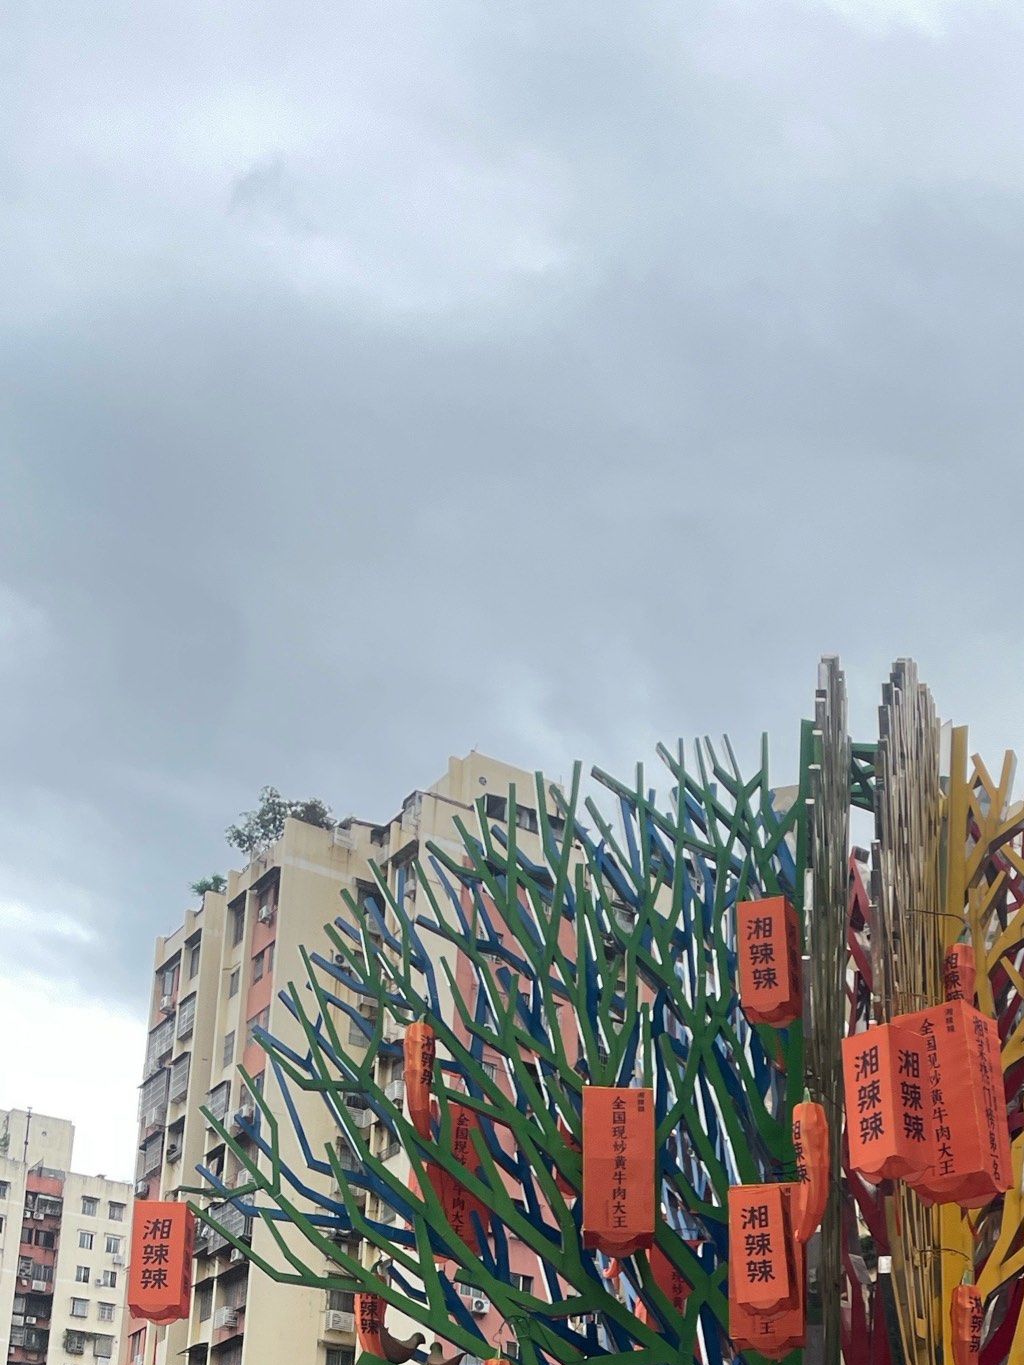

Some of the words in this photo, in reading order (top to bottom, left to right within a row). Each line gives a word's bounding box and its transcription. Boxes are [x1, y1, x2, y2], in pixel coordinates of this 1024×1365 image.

[747, 917, 779, 990] 湘辣辣
[854, 1045, 885, 1145] 湘辣辣
[898, 1049, 927, 1143] 湘辣辣
[140, 1218, 173, 1290] 湘辣辣
[741, 1205, 776, 1284] 湘辣辣
